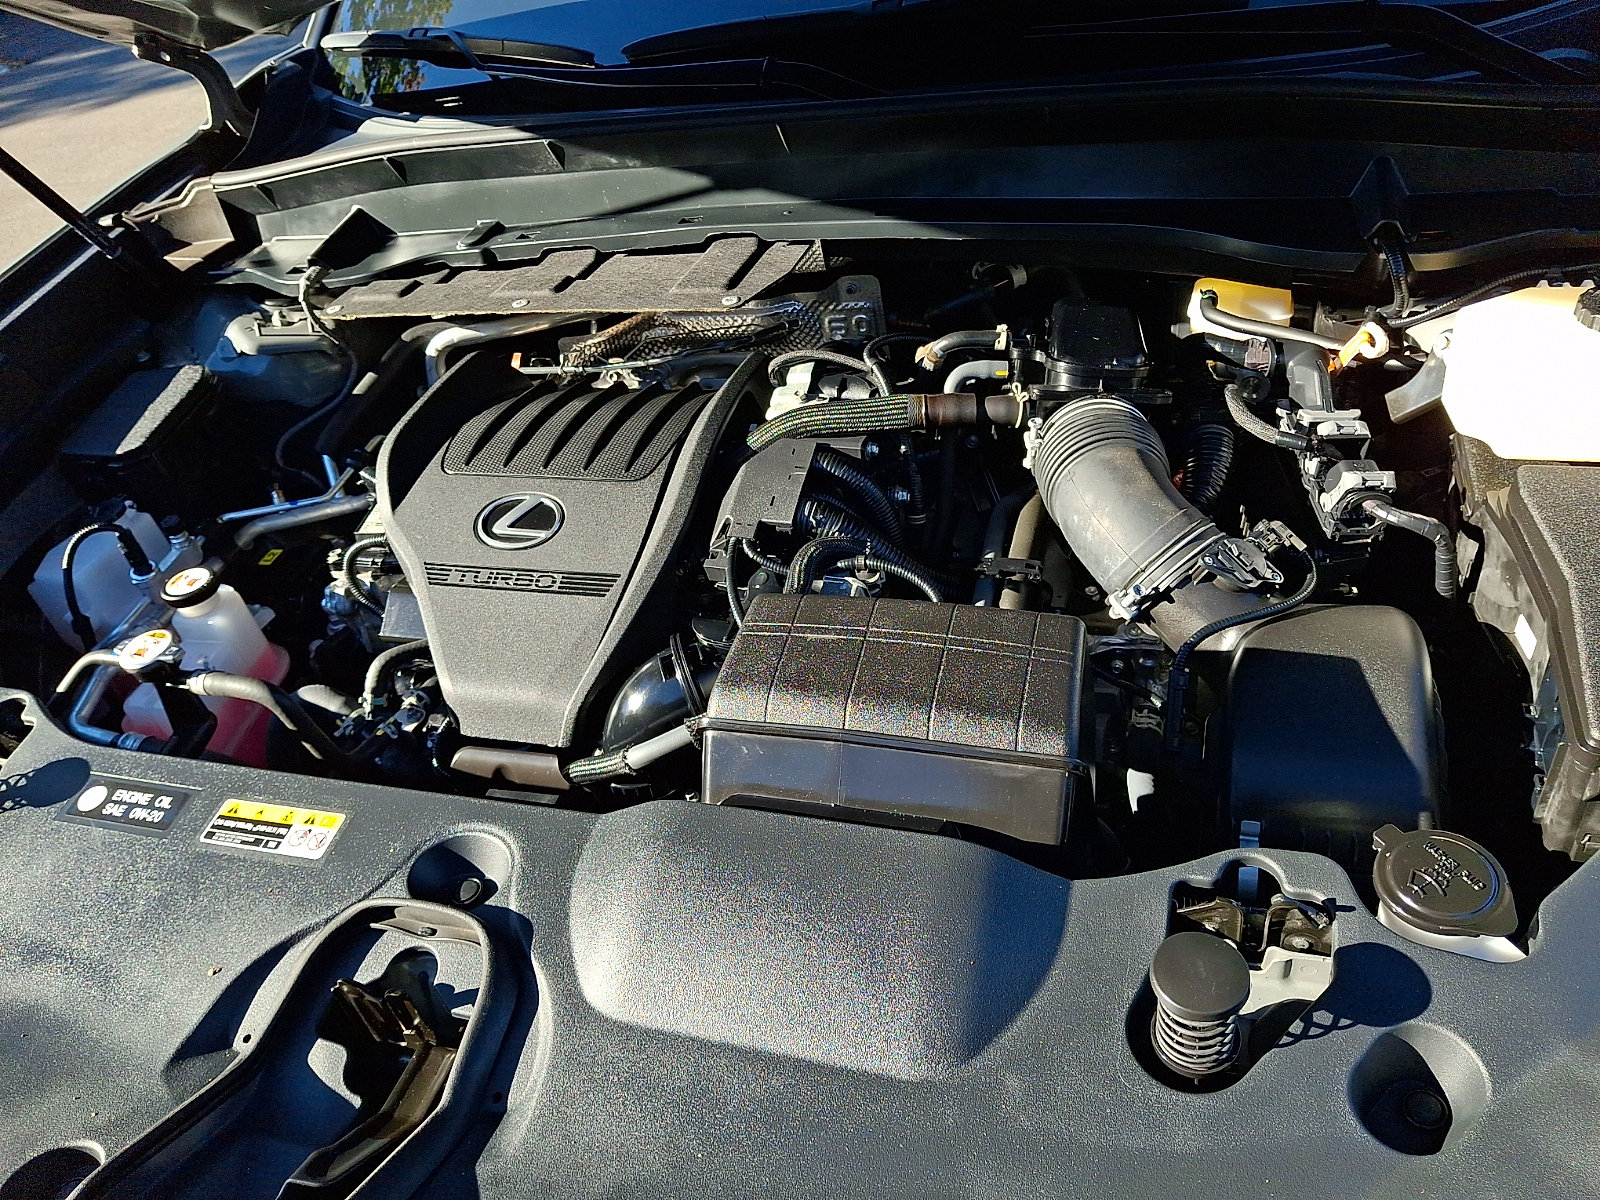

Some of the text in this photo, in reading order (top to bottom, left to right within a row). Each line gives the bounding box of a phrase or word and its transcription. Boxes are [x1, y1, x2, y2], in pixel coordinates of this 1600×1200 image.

[453, 567, 560, 589] TURBO
[111, 788, 174, 810] ENGINE OIL
[101, 802, 165, 824] SAE 0W-20
